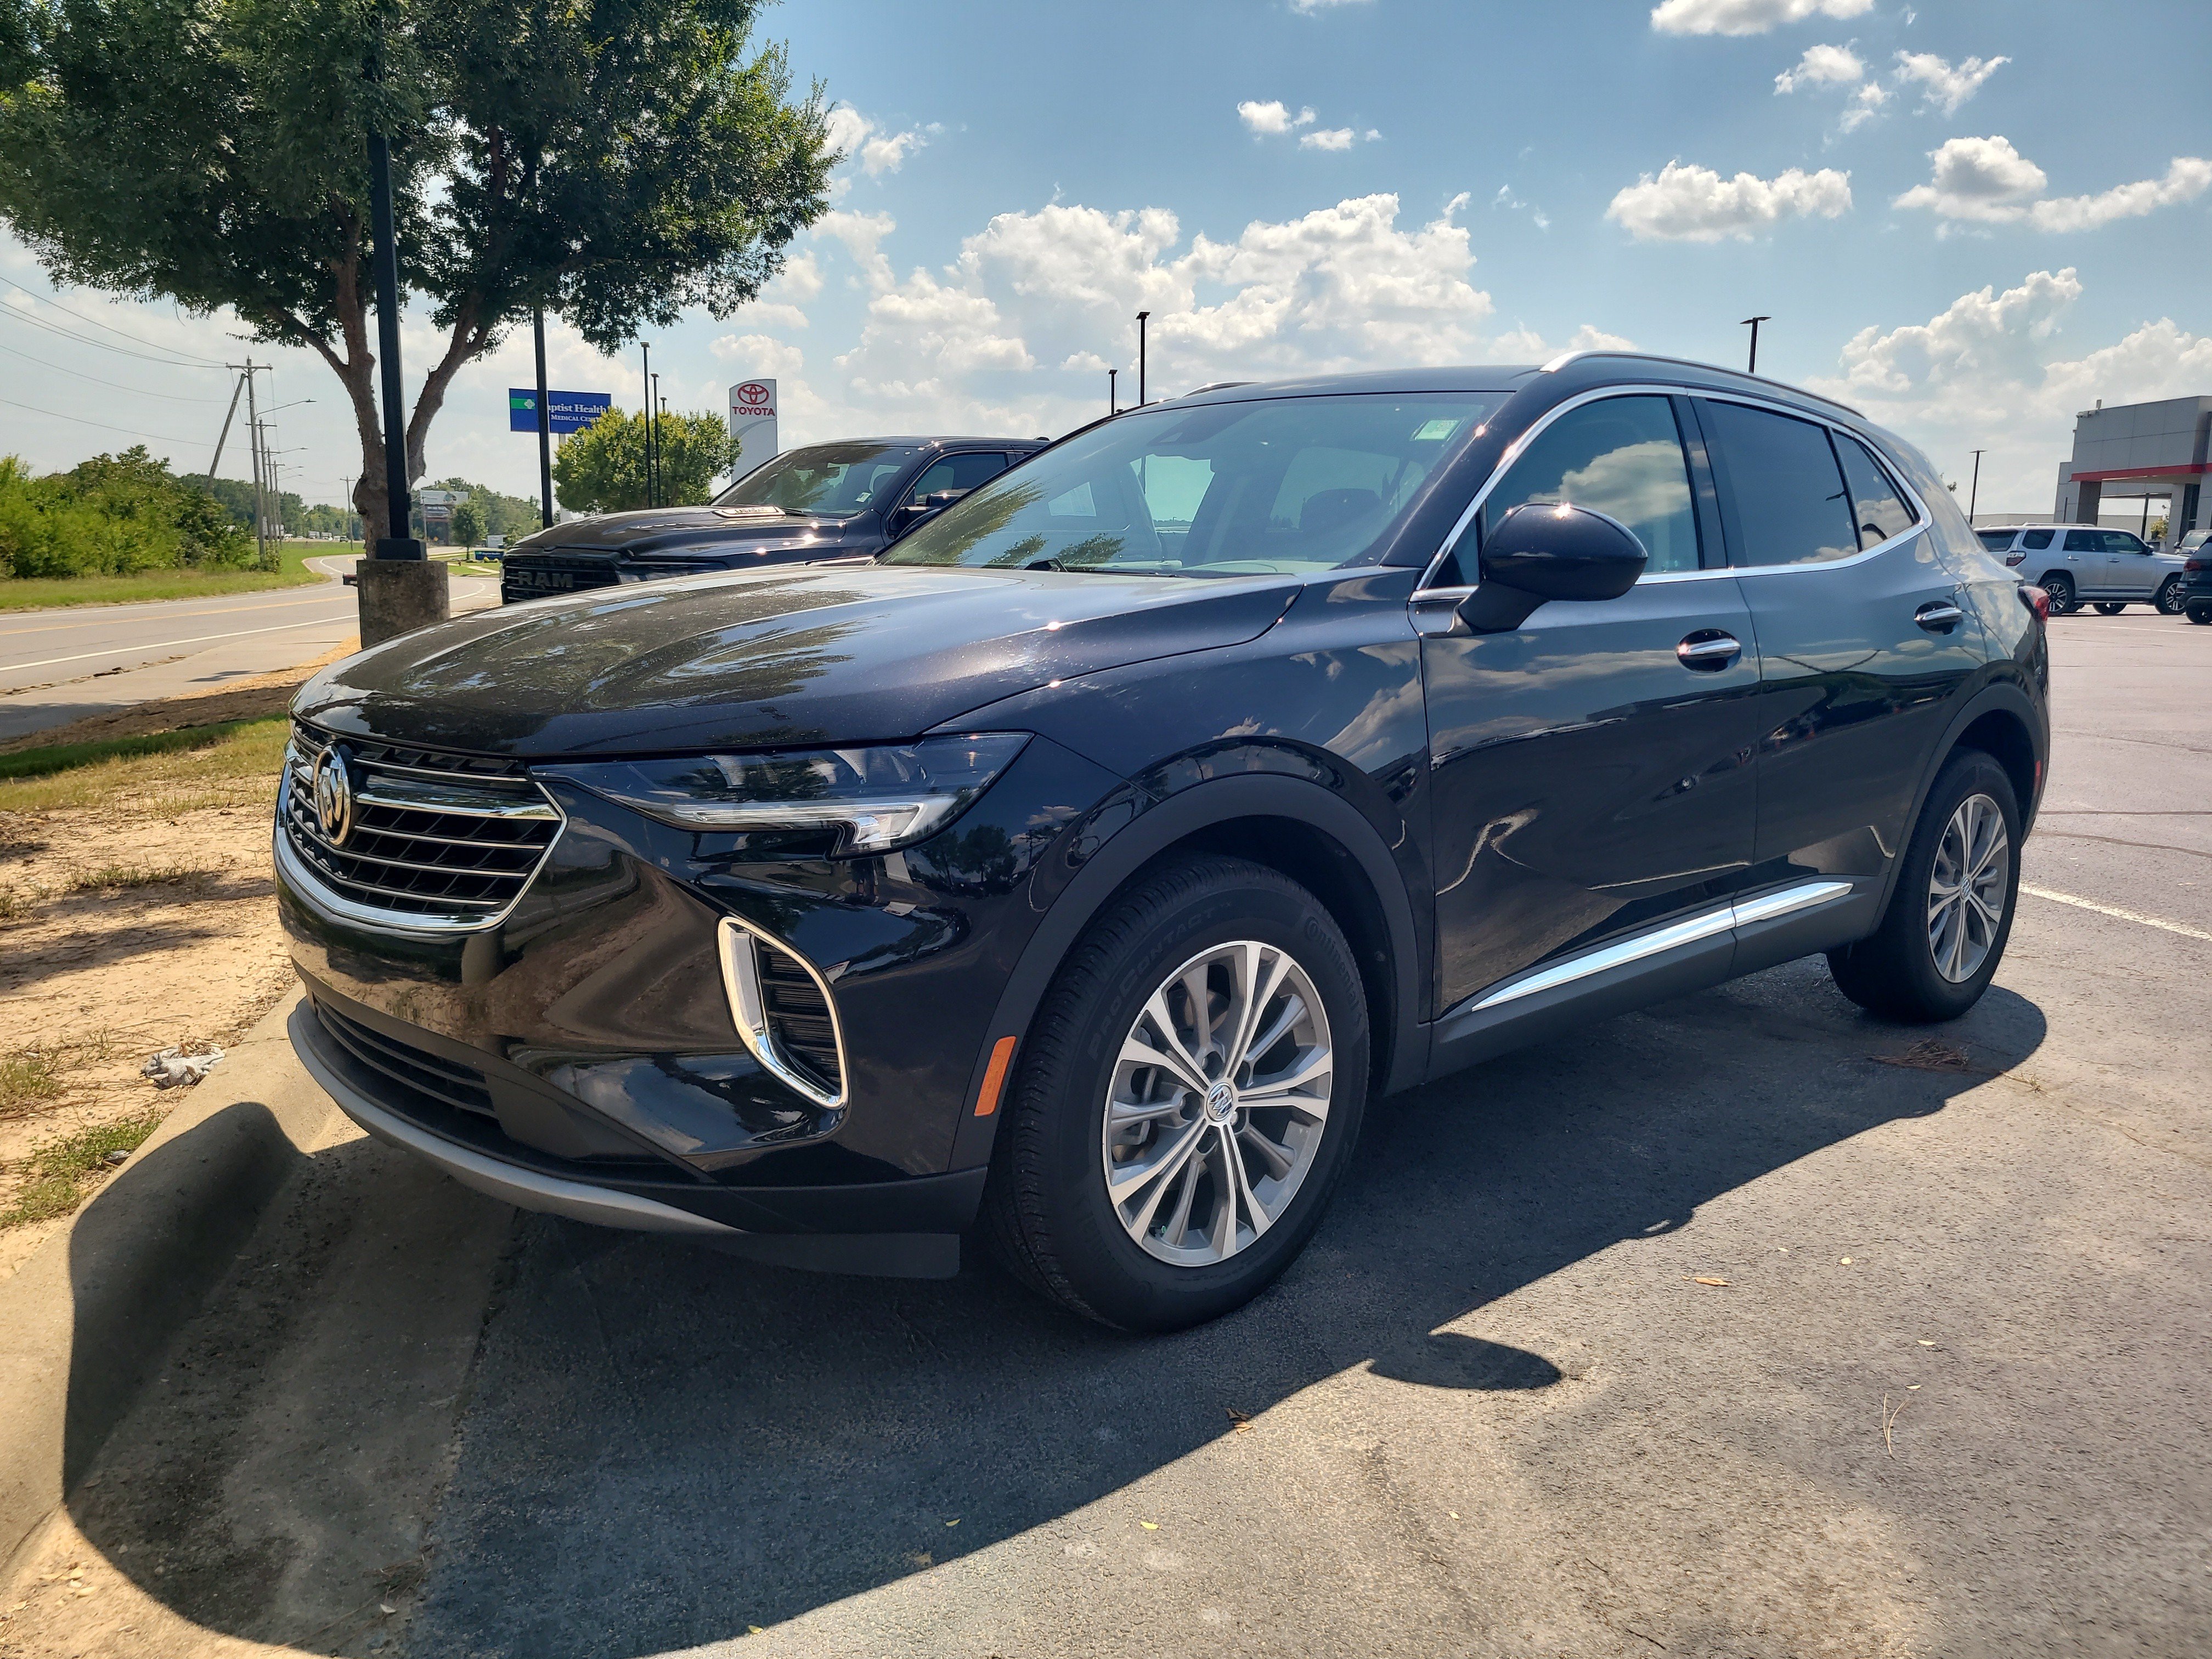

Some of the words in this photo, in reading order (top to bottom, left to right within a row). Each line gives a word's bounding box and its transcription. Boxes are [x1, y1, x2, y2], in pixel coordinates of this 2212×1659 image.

[549, 403, 574, 413] ptist
[574, 404, 607, 414] Health
[732, 407, 775, 416] TOYOTA
[518, 571, 573, 588] RAM
